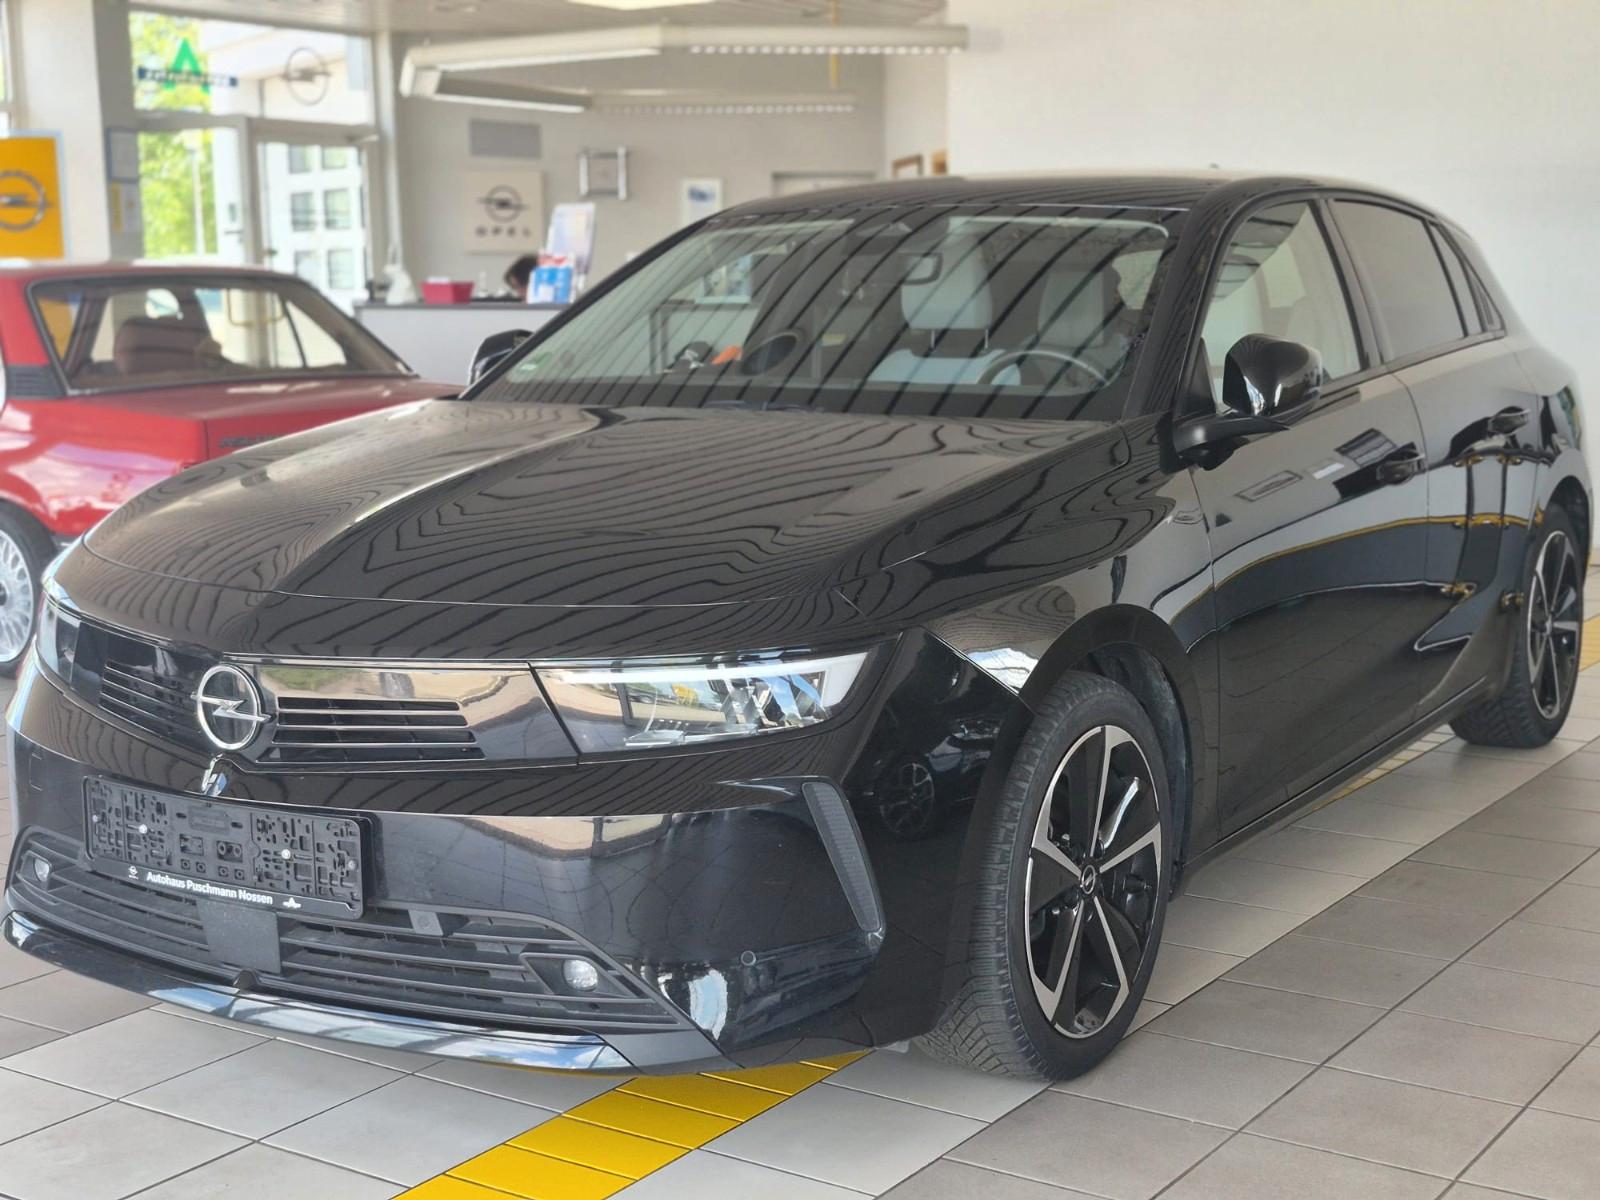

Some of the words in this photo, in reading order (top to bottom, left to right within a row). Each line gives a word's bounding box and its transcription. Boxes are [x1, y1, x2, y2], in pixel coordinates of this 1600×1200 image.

[146, 871, 186, 889] Autohaus
[186, 879, 237, 899] Puschmann
[238, 889, 273, 905] Nossen
